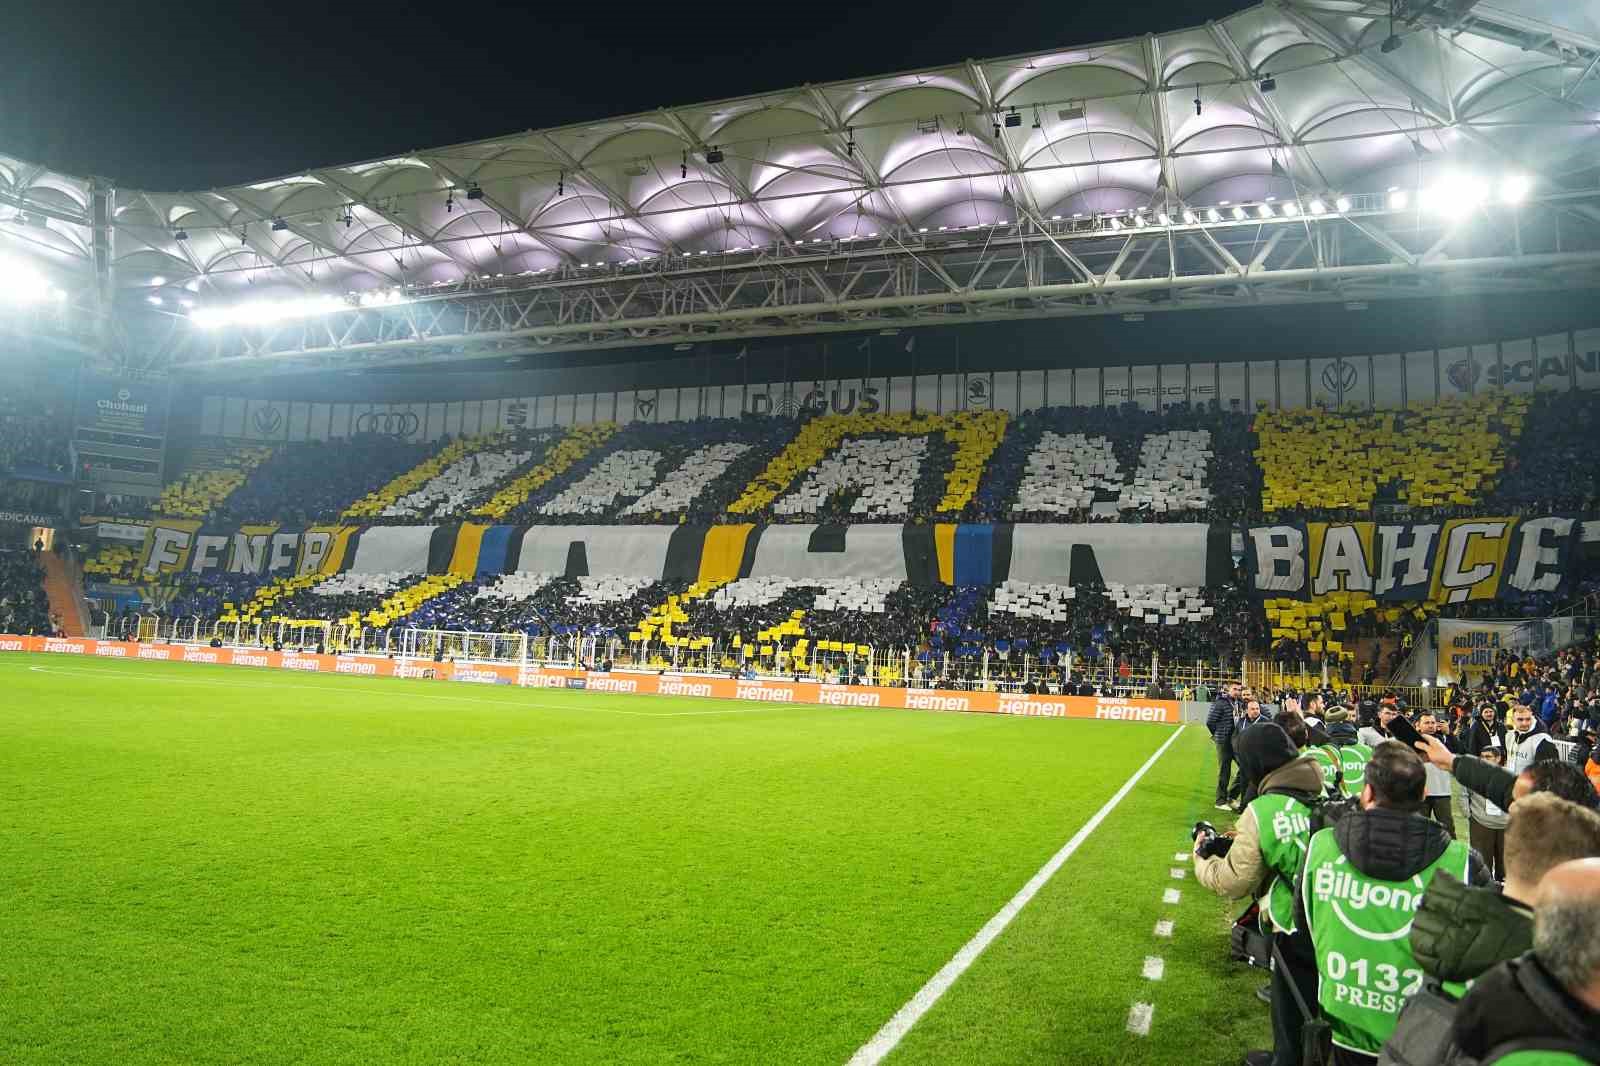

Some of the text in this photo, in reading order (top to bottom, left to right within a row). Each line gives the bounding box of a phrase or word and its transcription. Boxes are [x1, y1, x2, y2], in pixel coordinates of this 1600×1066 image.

[1248, 516, 1577, 604] BAHÇE
[335, 660, 377, 675] Hemen
[585, 676, 638, 693] Hemen
[657, 680, 713, 697] Hemen
[735, 686, 794, 702] Hemen
[817, 691, 881, 707] Hemen
[904, 695, 970, 711] Hemen
[997, 699, 1067, 717] Hemen
[1095, 704, 1168, 722] Hemen
